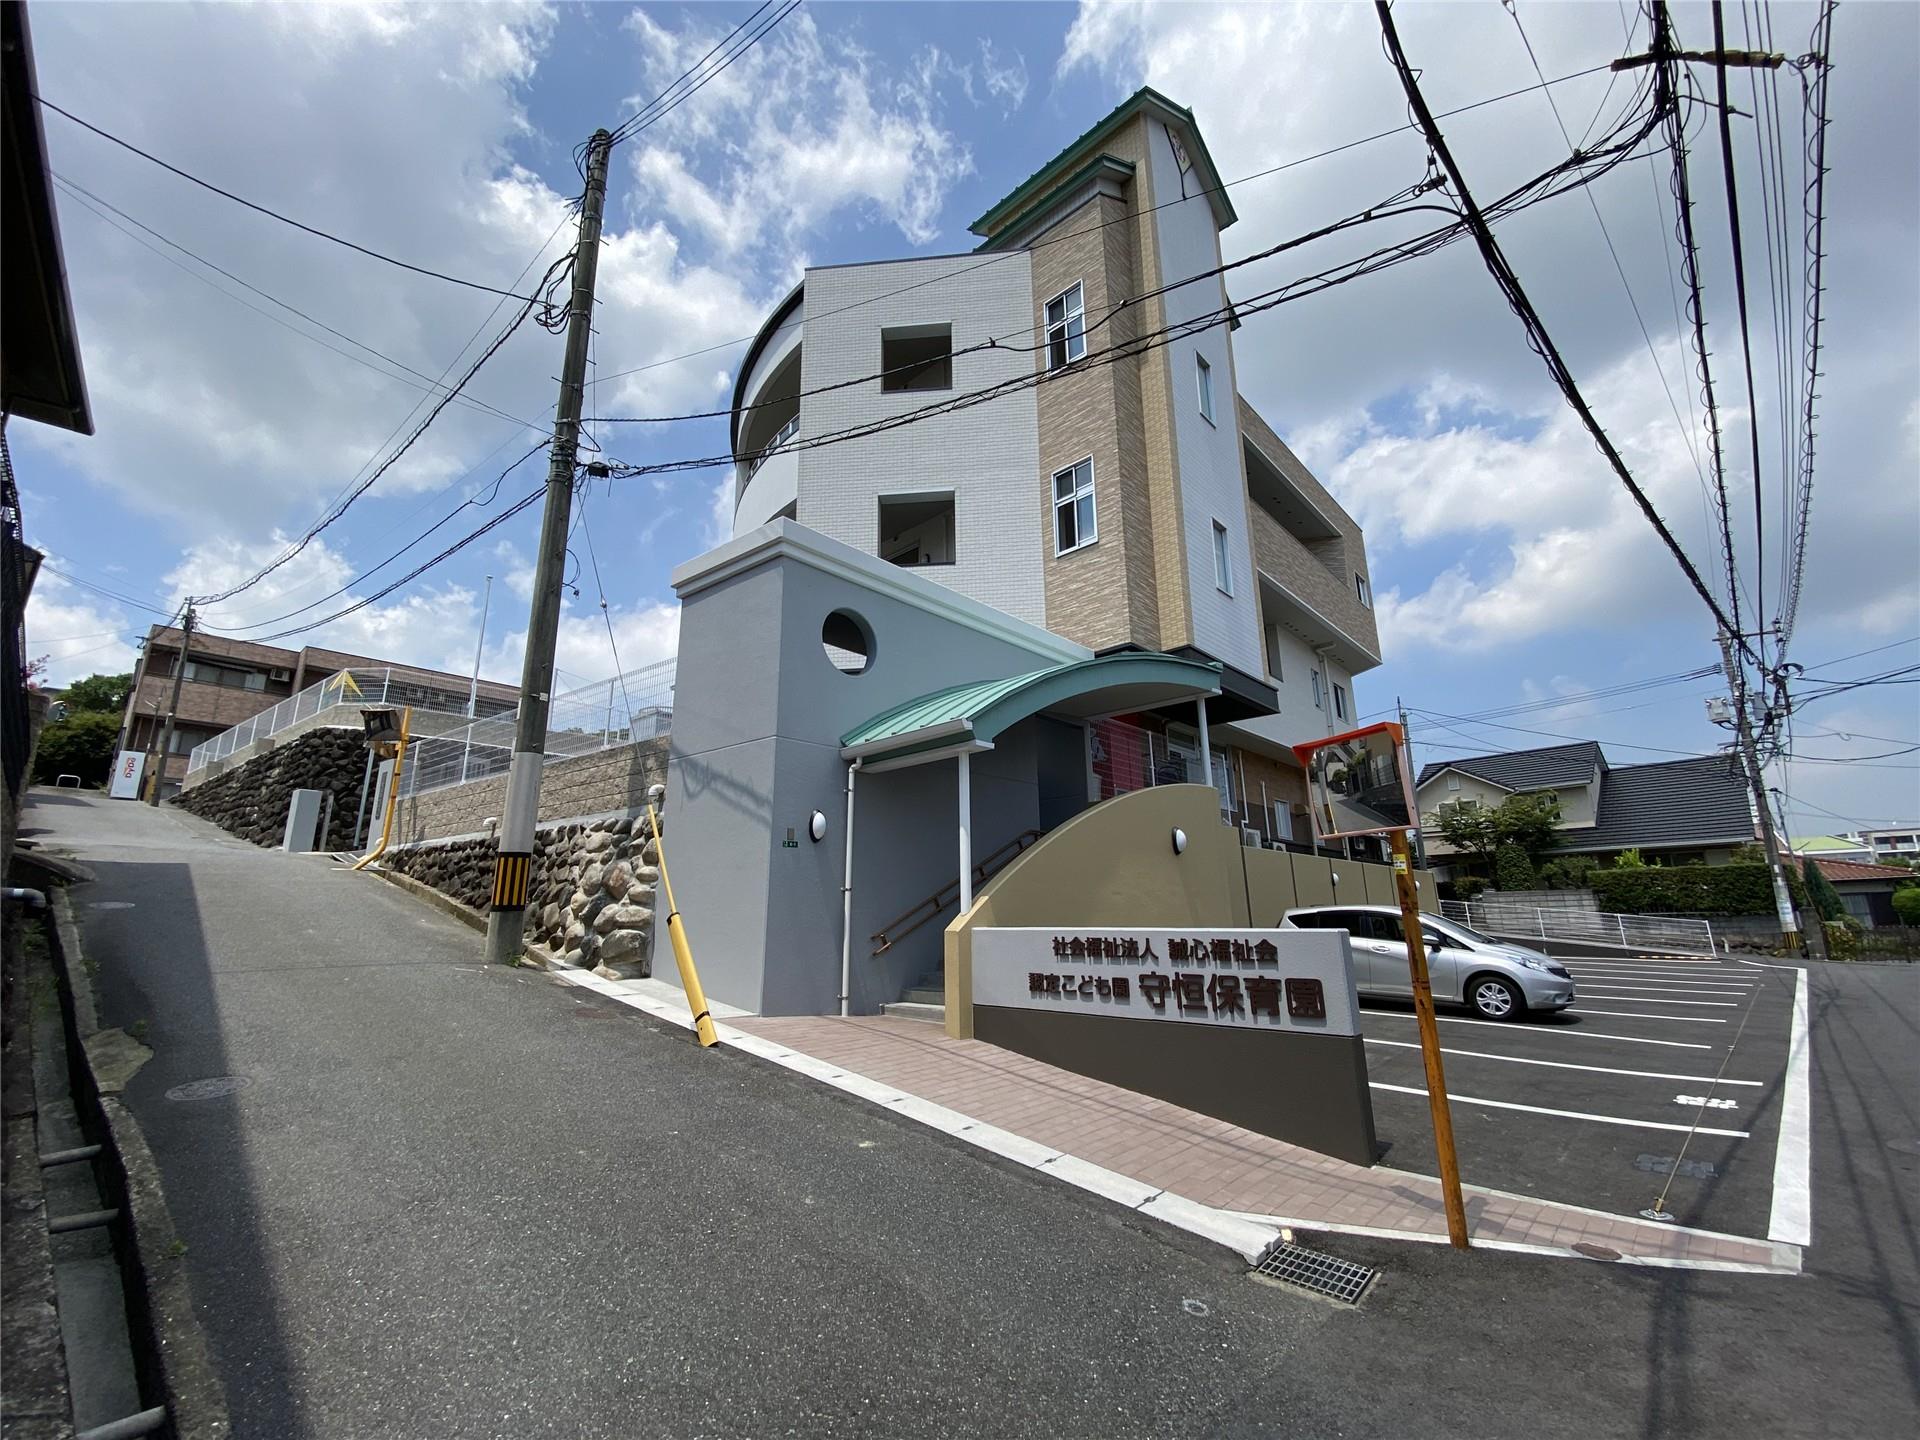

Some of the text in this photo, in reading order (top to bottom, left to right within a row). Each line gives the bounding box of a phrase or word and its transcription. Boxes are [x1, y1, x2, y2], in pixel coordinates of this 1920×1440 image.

[1052, 936, 1159, 959] 社会福祉法人
[1028, 971, 1327, 1019] 認定こども園 守恒保育園
